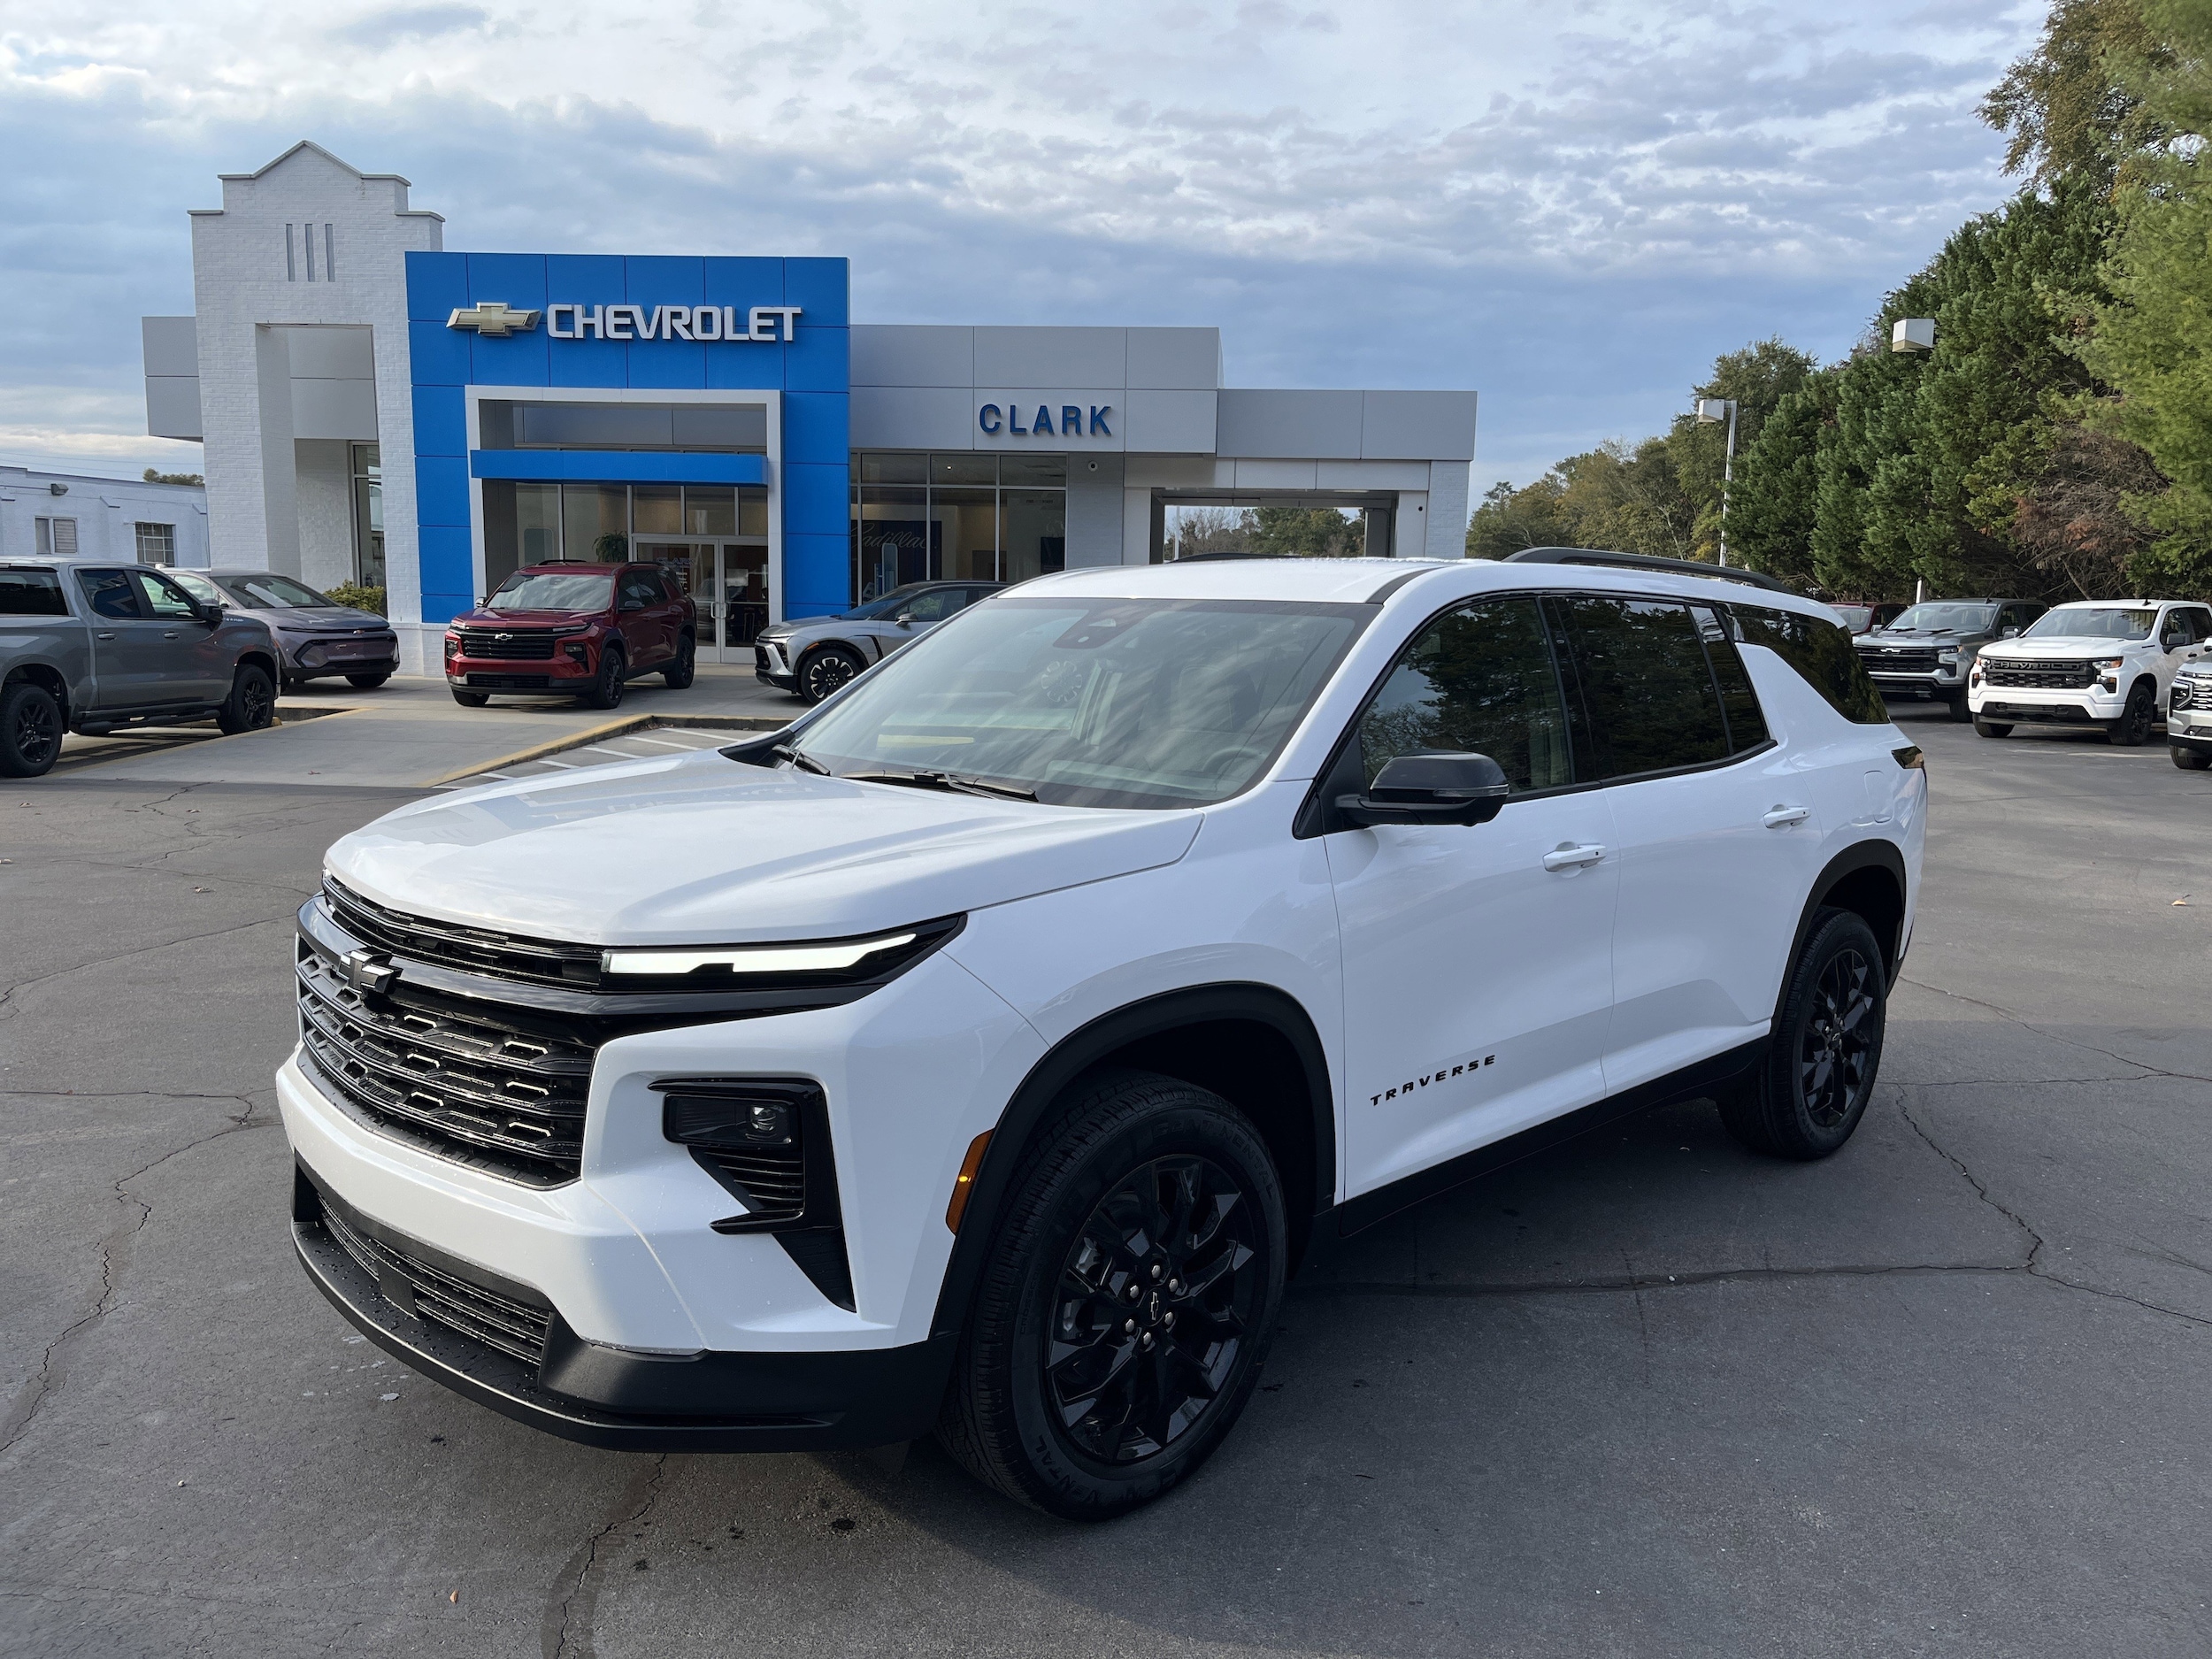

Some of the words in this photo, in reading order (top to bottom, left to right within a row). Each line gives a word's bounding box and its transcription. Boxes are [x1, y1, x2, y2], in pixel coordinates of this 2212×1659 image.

[547, 303, 803, 342] CHEVROLET
[979, 403, 1112, 436] CLARK
[850, 522, 926, 549] Cadillac
[1370, 1054, 1496, 1107] TRAVERSE
